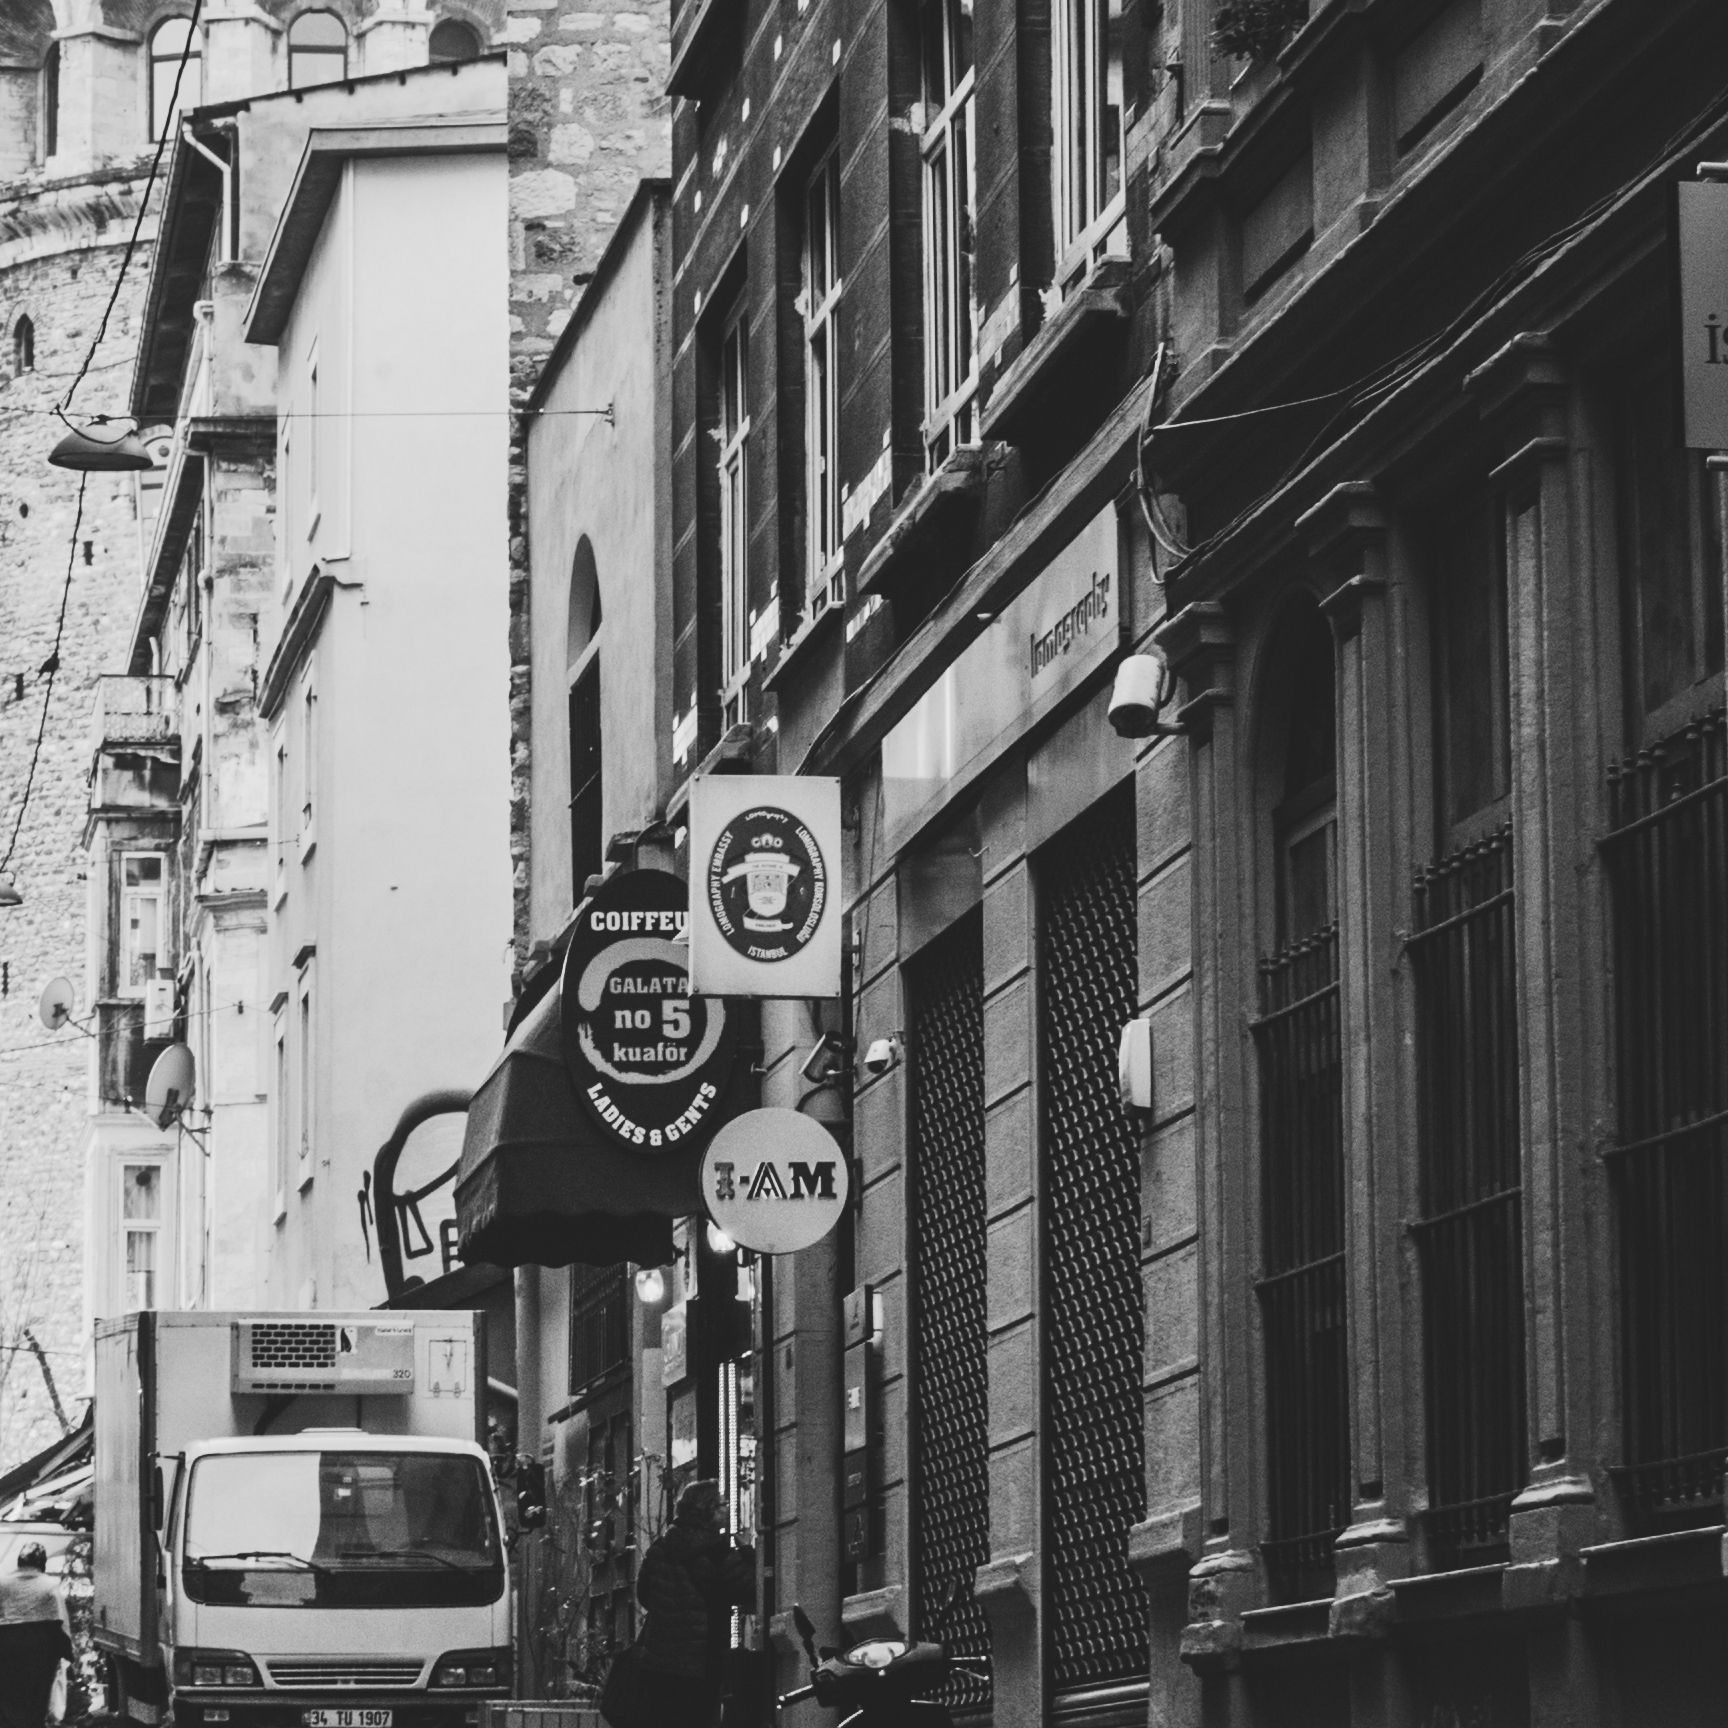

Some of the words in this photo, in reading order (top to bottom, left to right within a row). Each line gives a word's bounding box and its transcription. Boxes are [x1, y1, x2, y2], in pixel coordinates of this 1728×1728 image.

[1030, 571, 1110, 679] lomography
[711, 831, 733, 872] EMBASSY
[795, 825, 824, 880] LOMOGRAPHY
[590, 911, 689, 931] COIFFEU
[710, 875, 735, 936] LOMOGRAPHY
[609, 976, 689, 994] GALATA
[614, 1009, 651, 1029] no
[661, 999, 691, 1039] 5
[613, 1042, 688, 1062] kuaför
[587, 1082, 646, 1144] LADIES
[649, 1129, 662, 1146] &
[664, 1081, 717, 1142] GENTS
[714, 1161, 837, 1200] I-AM
[312, 1711, 328, 1726] 34
[336, 1711, 353, 1726] TU
[358, 1711, 390, 1726] 1907
